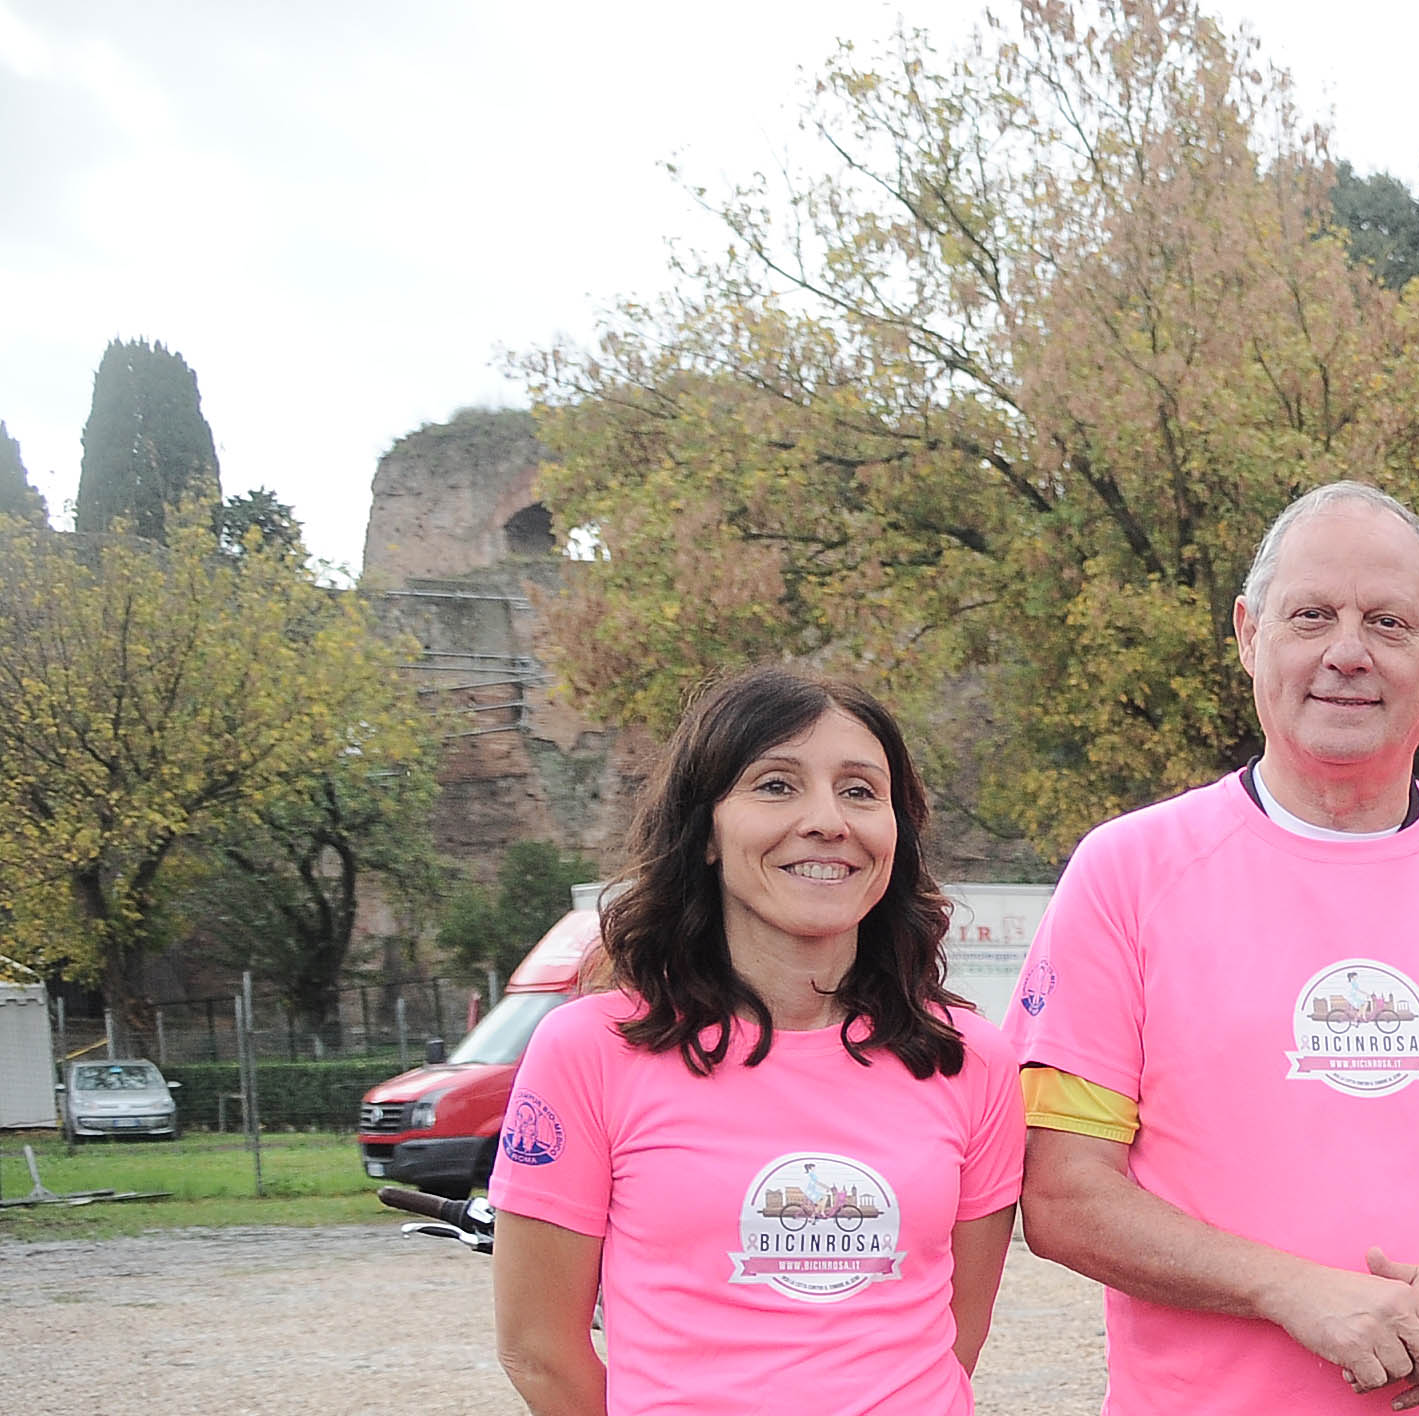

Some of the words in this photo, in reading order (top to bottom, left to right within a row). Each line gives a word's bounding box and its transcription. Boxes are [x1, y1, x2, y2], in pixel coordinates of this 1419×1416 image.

[1311, 1035, 1418, 1052] BICINROSA
[760, 1233, 881, 1252] BICINROSA
[778, 1260, 861, 1271] WWW.BICINROSA.IT
